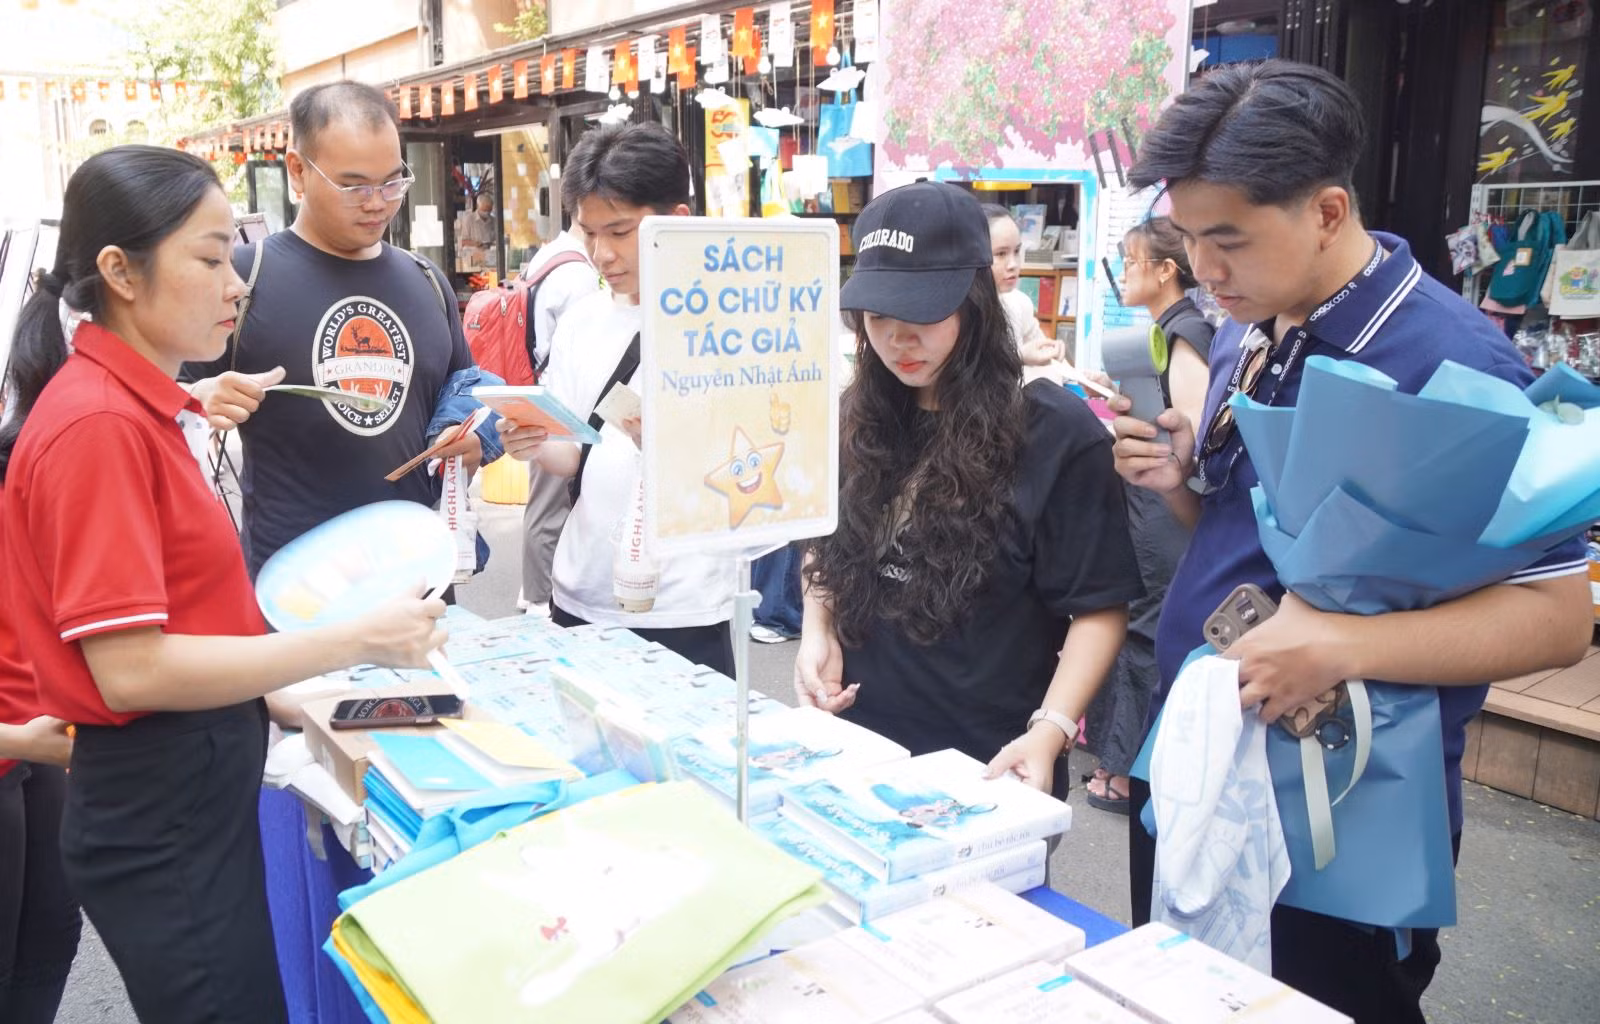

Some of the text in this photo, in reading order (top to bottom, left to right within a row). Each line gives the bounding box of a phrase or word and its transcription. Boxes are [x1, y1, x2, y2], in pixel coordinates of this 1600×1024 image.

[703, 236, 783, 273] SÁCH
[858, 228, 914, 253] COLORADO
[660, 278, 823, 316] CÓ CHỮ KÝ
[322, 303, 407, 360] WORLD'S GREATEST
[684, 317, 801, 358] TÁC GIẢ
[334, 360, 397, 376] GRANDPA
[739, 364, 783, 388] Nhật
[786, 359, 823, 383] Ánh
[374, 387, 401, 425] SELECT
